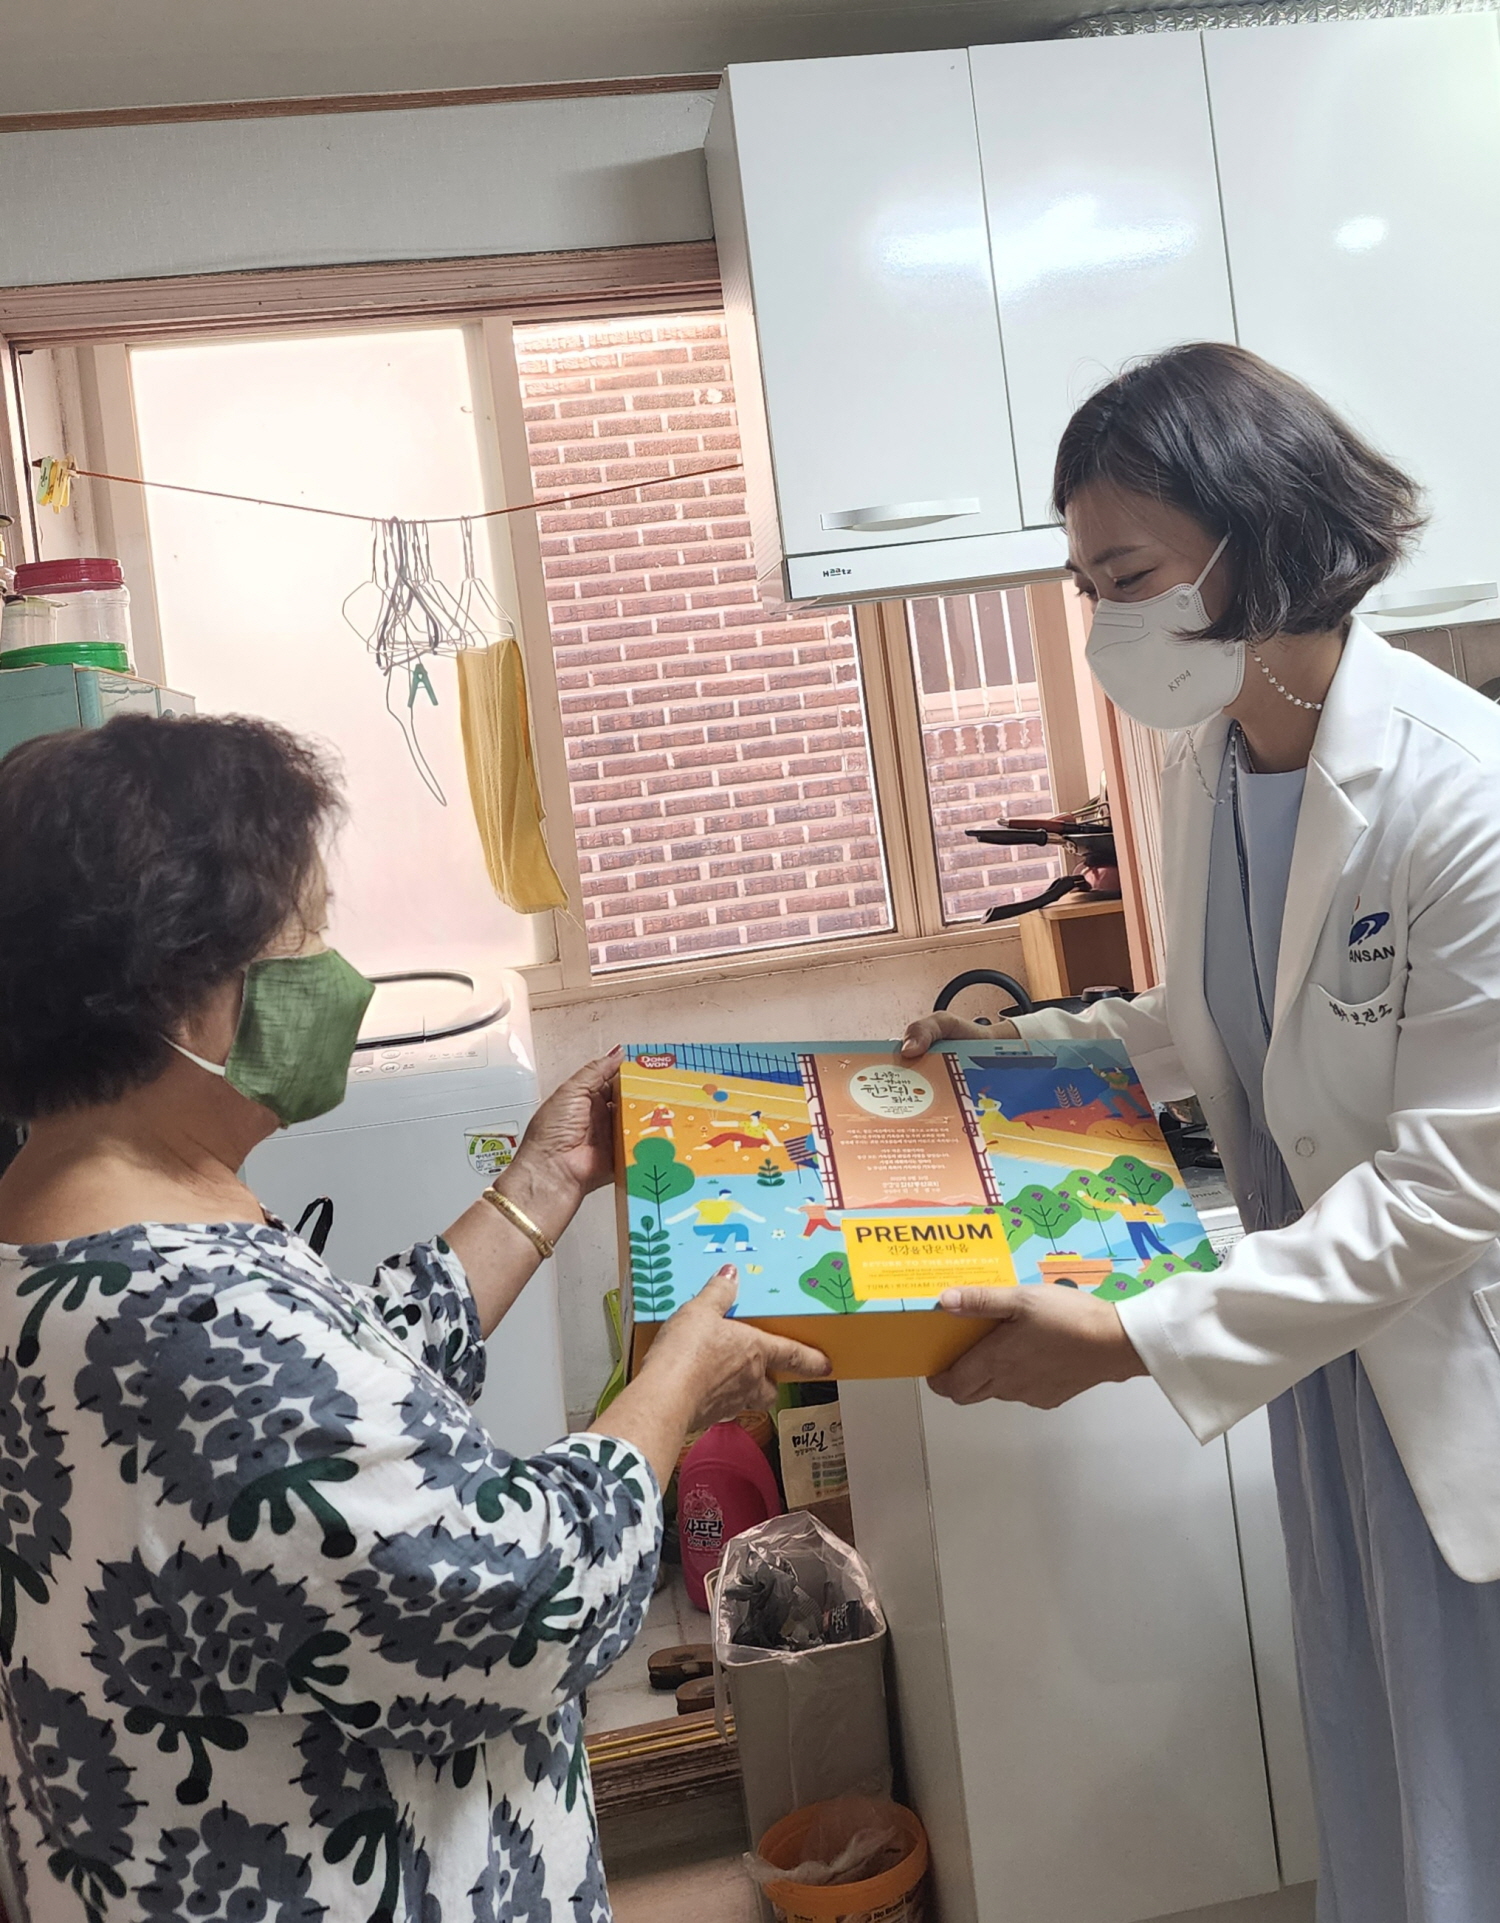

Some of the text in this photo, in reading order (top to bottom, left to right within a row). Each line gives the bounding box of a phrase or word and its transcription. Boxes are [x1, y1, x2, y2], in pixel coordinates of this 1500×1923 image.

[822, 567, 852, 578] Haatz
[1167, 669, 1192, 692] KF94
[1348, 945, 1395, 963] ANSAN
[860, 1084, 909, 1098] 한가위
[489, 1142, 497, 1151] 2
[856, 1224, 993, 1243] PREMIUM
[887, 1243, 969, 1256] 건강을 담은 마음
[945, 1258, 977, 1266] HAPPY
[980, 1257, 1000, 1265] DAY
[792, 1431, 828, 1452] 매실
[873, 1910, 885, 1920] No
